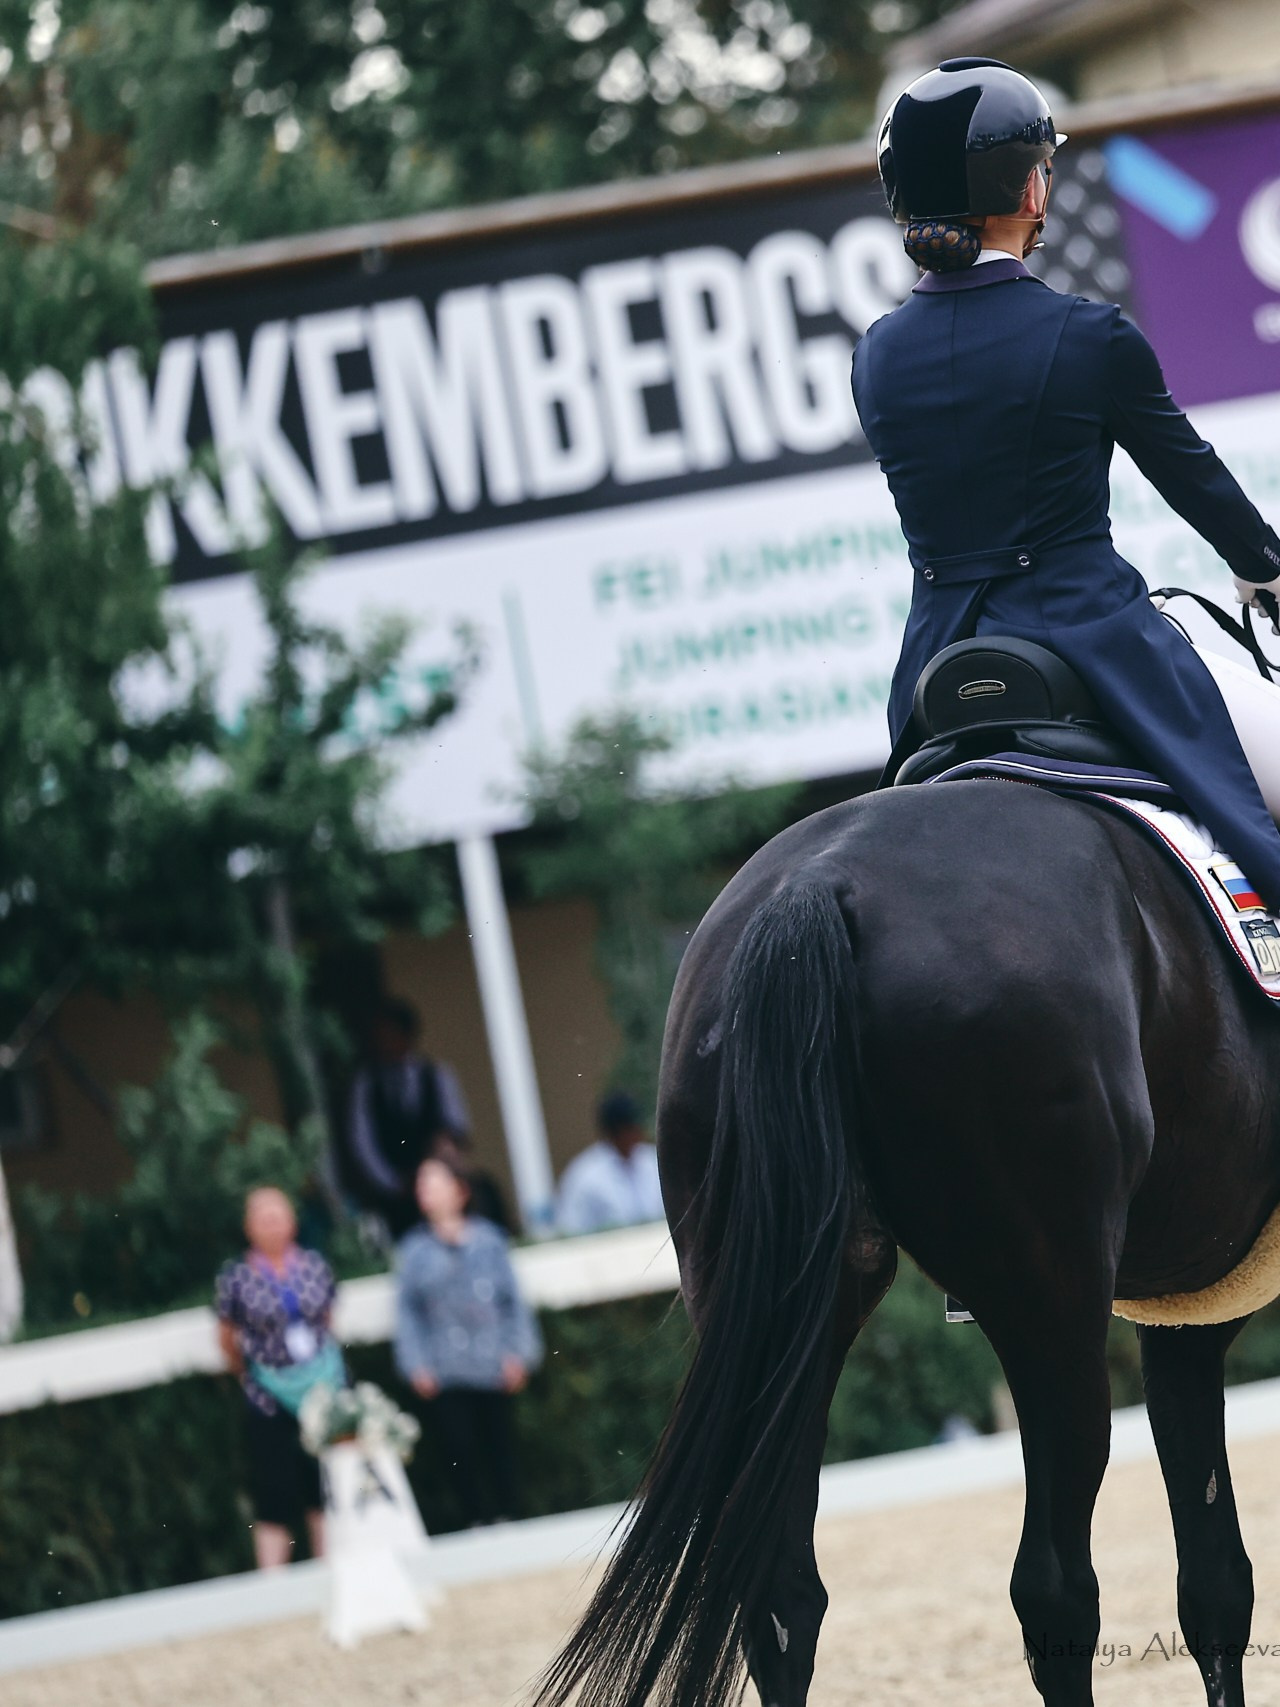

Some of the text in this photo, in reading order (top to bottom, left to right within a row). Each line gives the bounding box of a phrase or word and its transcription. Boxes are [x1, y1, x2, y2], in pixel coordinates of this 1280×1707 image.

[593, 559, 680, 610] FEI
[702, 522, 906, 598] JUMPIN
[617, 603, 873, 692] JUMPING
